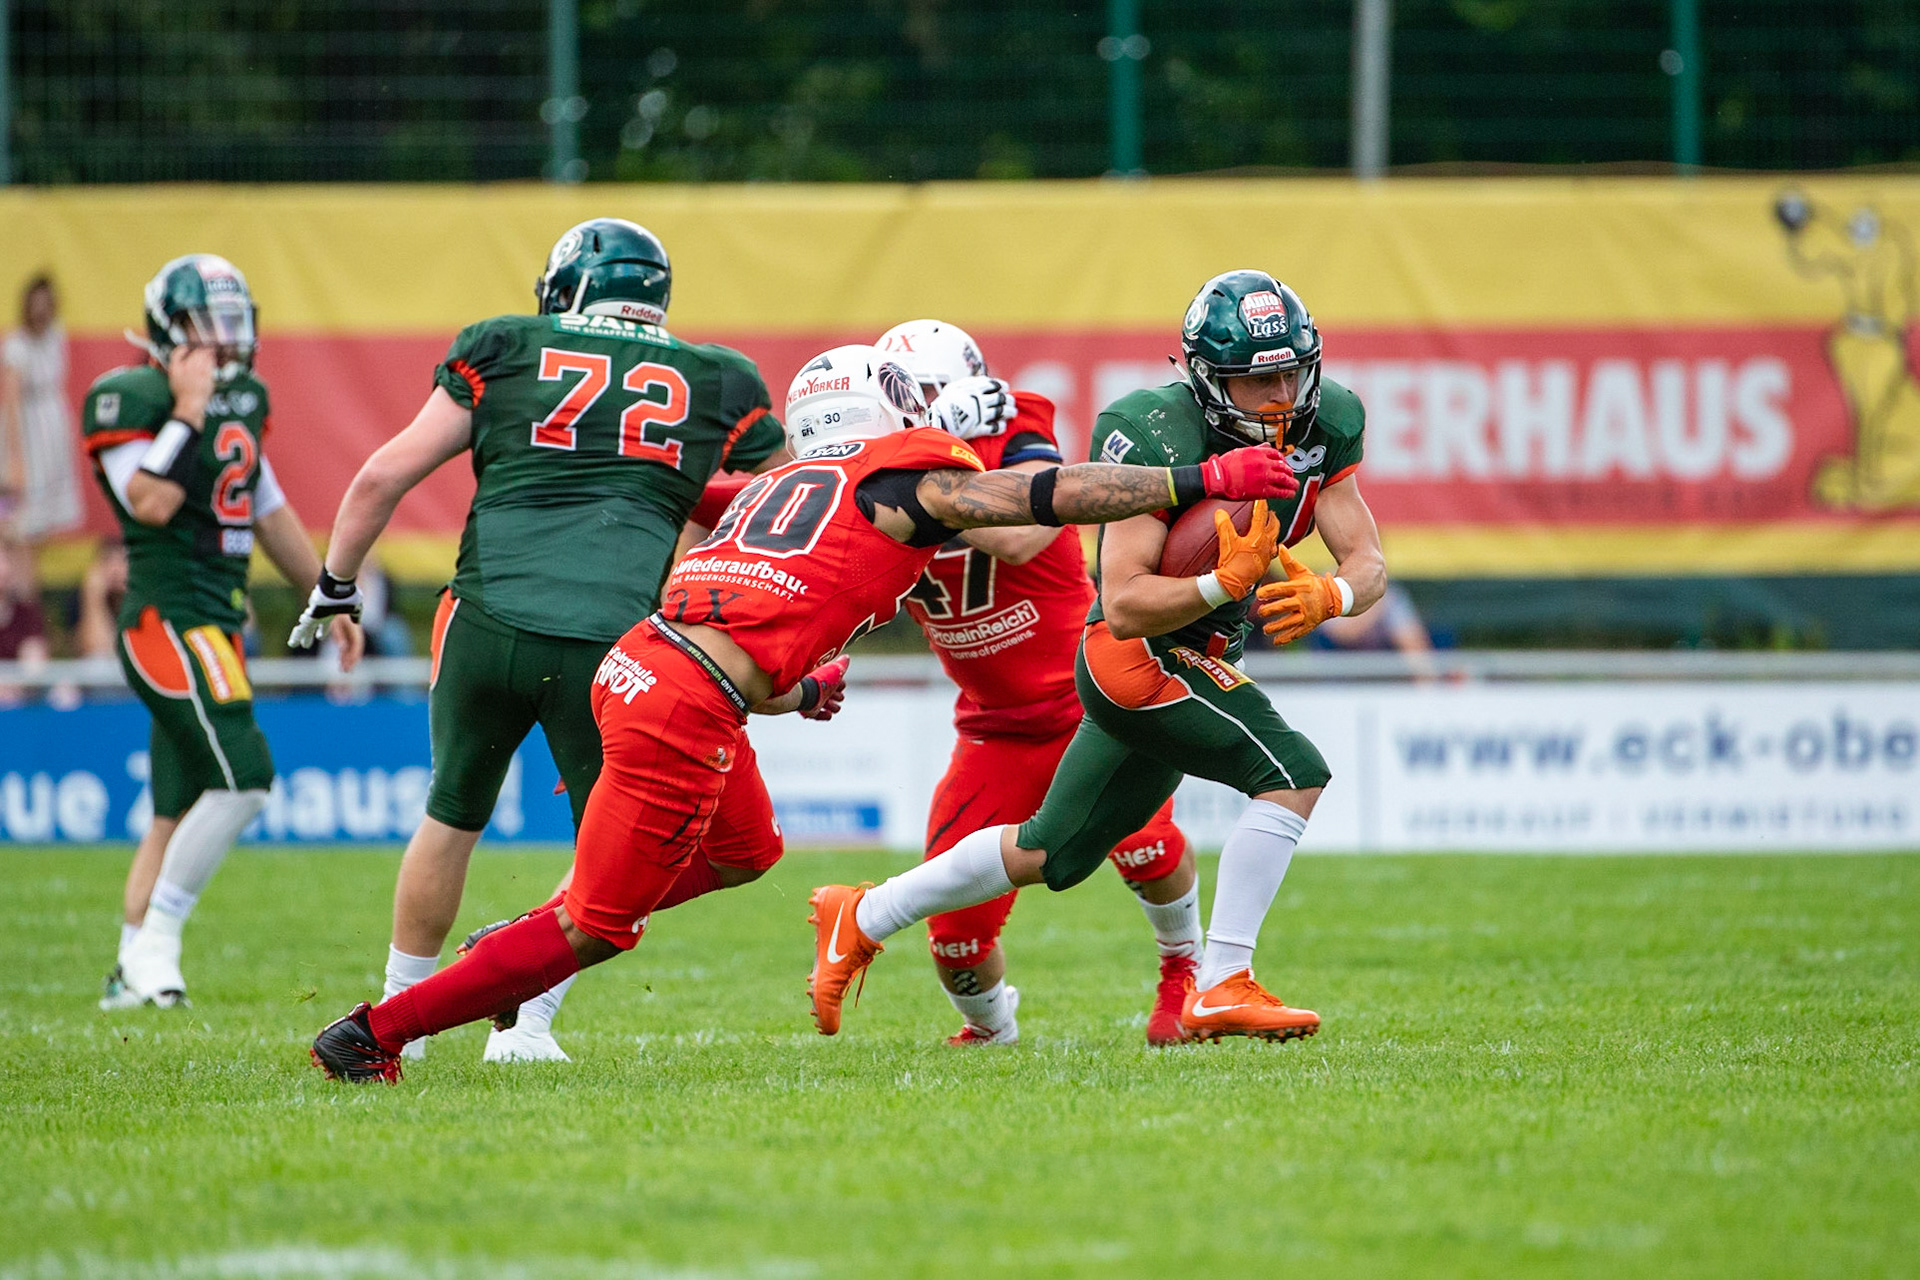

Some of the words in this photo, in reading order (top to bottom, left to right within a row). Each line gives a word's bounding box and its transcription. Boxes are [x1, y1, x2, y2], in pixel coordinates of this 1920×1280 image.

[620, 304, 664, 323] Riddell
[583, 327, 635, 339] SCHAFFEN
[1257, 350, 1291, 362] Riddell
[530, 347, 691, 470] 72
[824, 412, 841, 425] 30
[801, 427, 815, 437] GFL
[1107, 433, 1128, 456] W
[210, 421, 258, 526] 2
[930, 605, 1033, 645] ProteinReich
[1212, 668, 1235, 687] DAS
